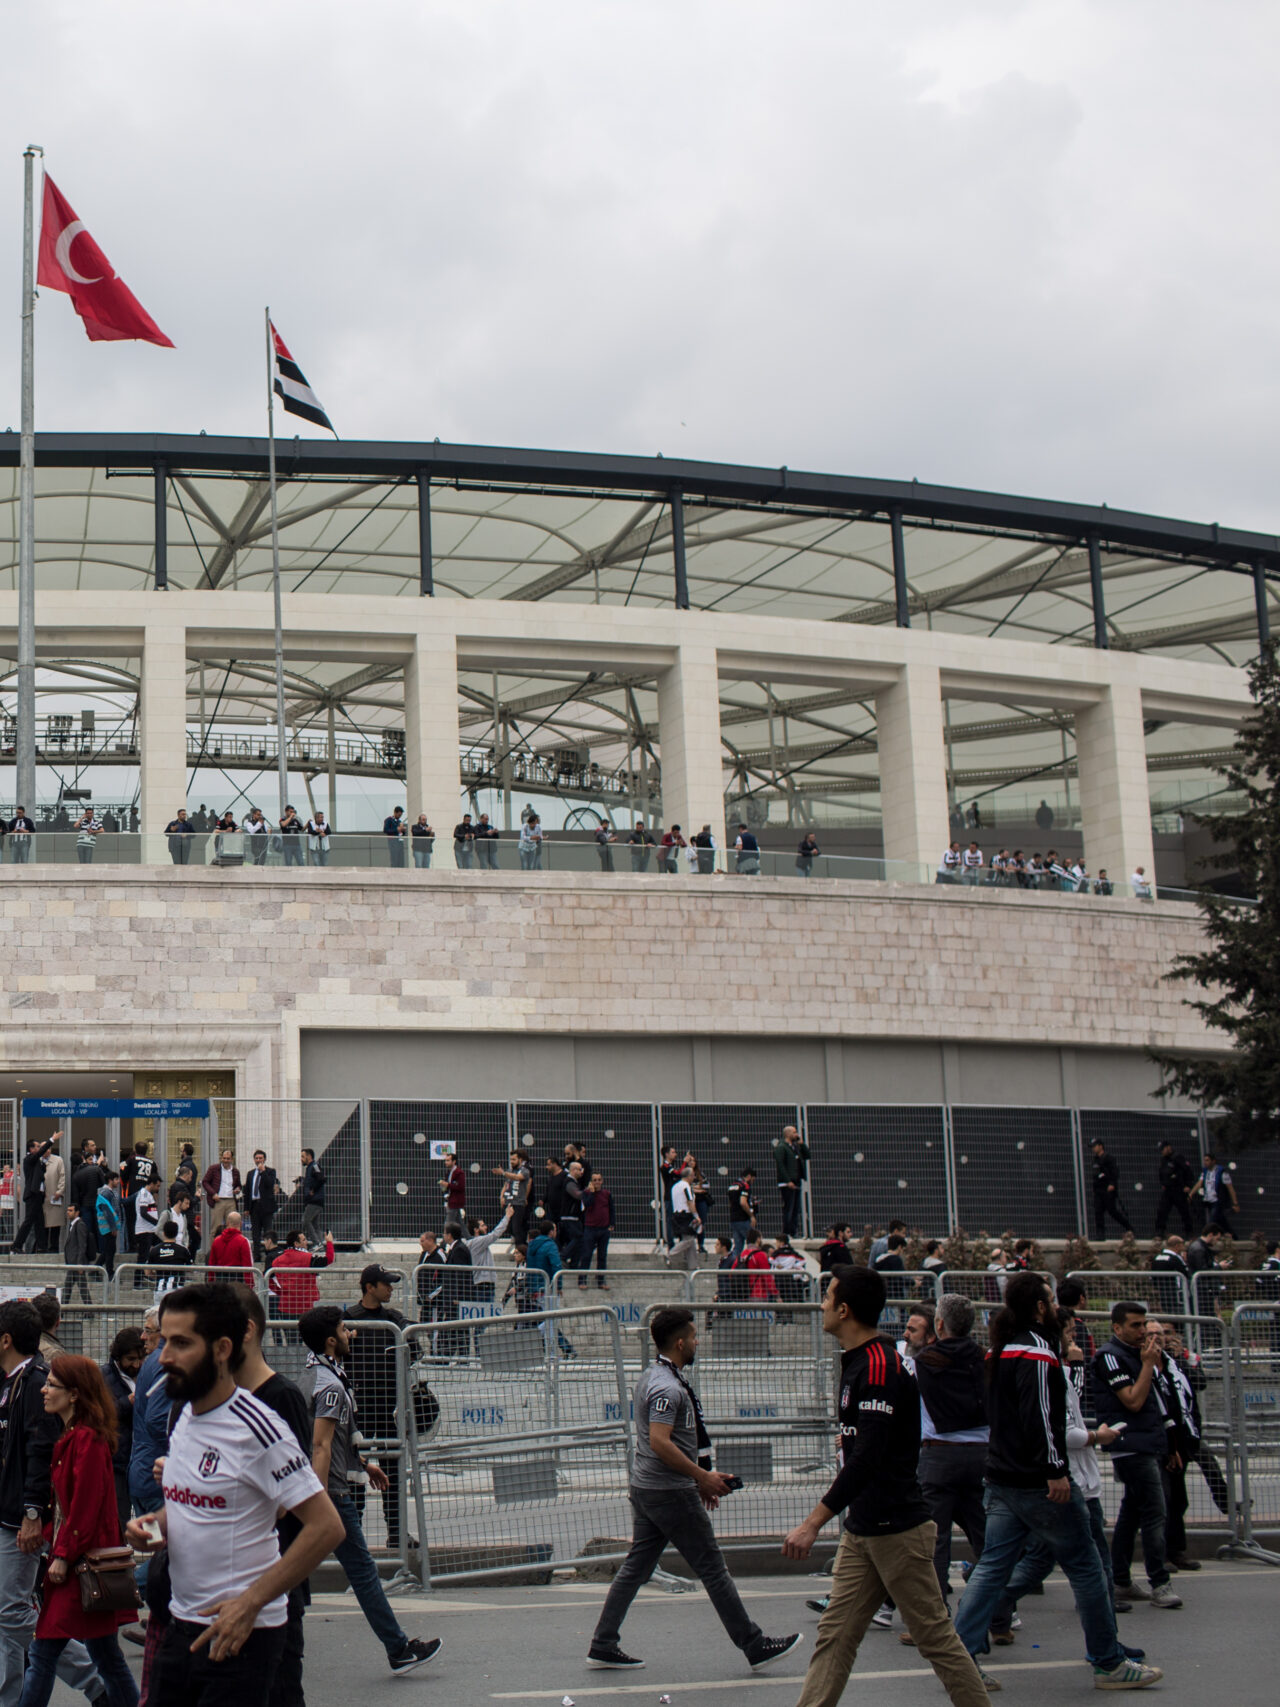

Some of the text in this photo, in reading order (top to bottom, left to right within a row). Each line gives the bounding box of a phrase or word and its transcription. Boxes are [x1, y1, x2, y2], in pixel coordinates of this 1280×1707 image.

[137, 1161, 152, 1177] 28
[462, 1406, 504, 1425] POLİS
[163, 1484, 227, 1509] odafone
